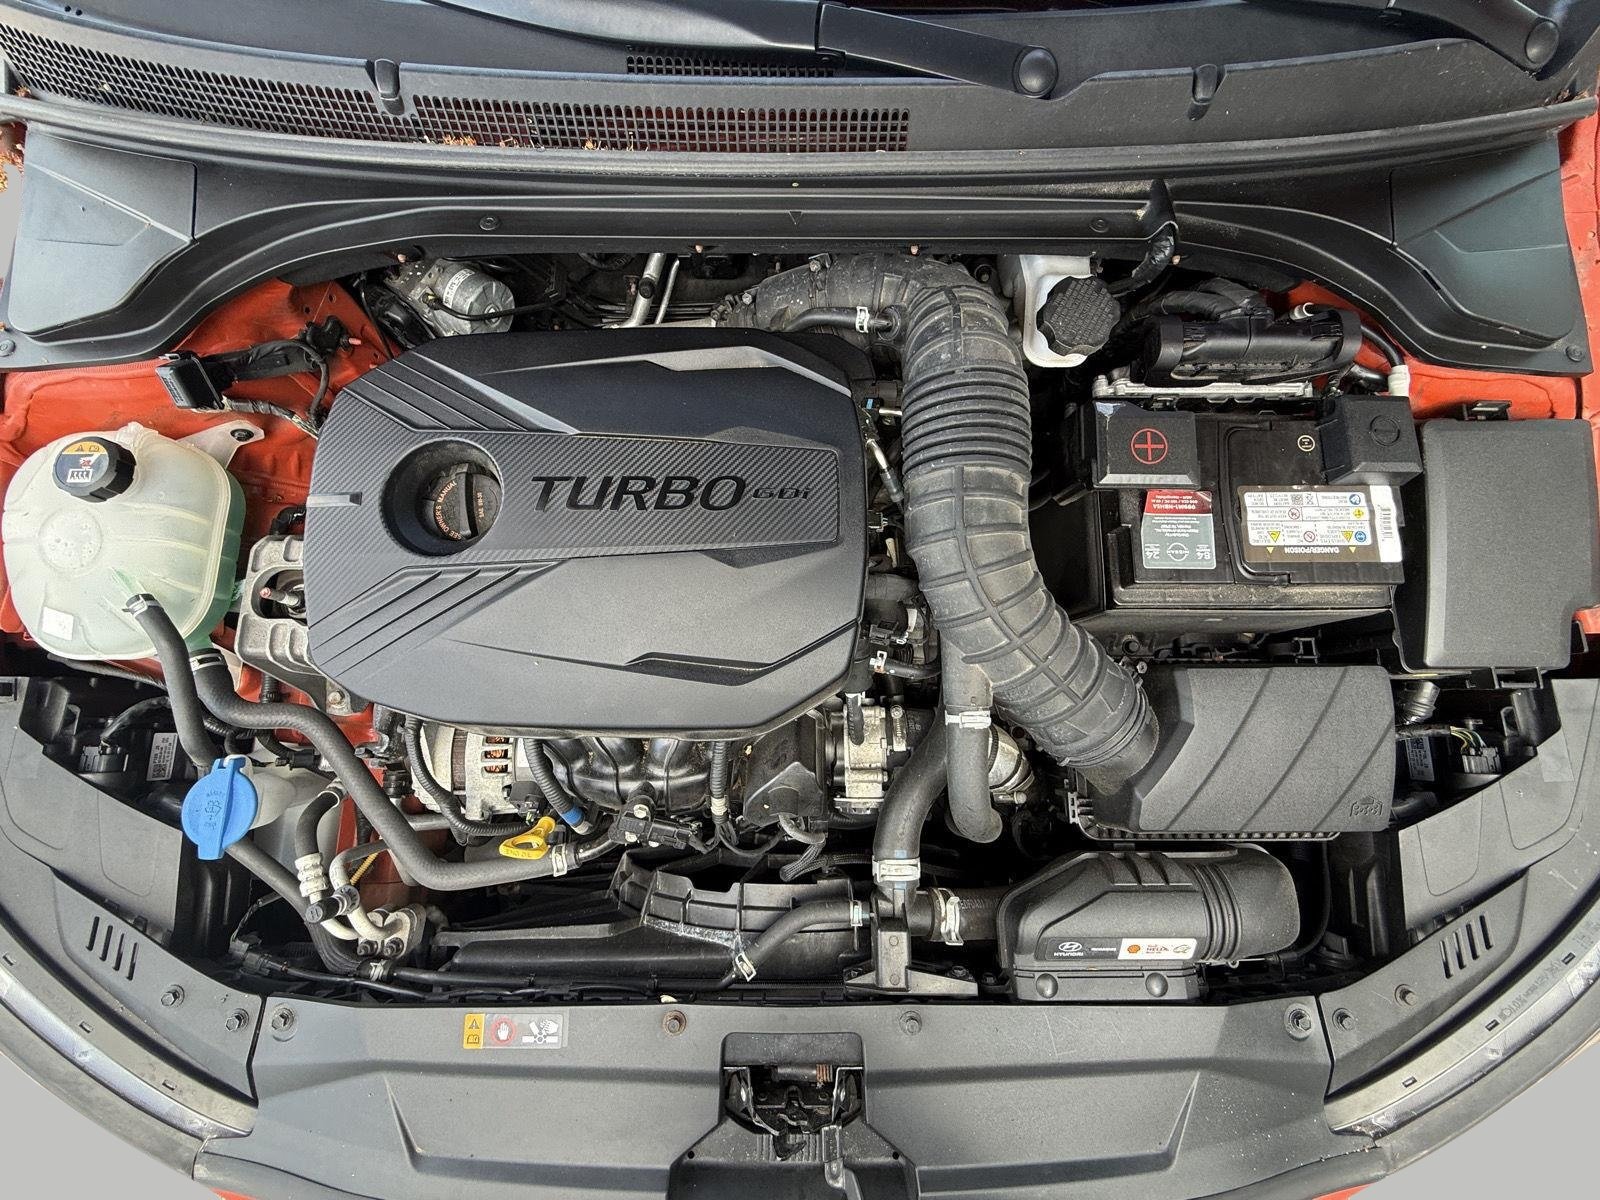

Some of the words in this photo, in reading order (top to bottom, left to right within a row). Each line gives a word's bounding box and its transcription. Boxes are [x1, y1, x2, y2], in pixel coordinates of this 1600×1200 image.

[437, 480, 458, 503] MANUAL
[531, 475, 747, 511] TURBO
[435, 505, 450, 532] OWNER'S
[448, 530, 462, 540] SEE
[1145, 551, 1160, 560] 24
[1284, 546, 1340, 554] DANGER/POISON
